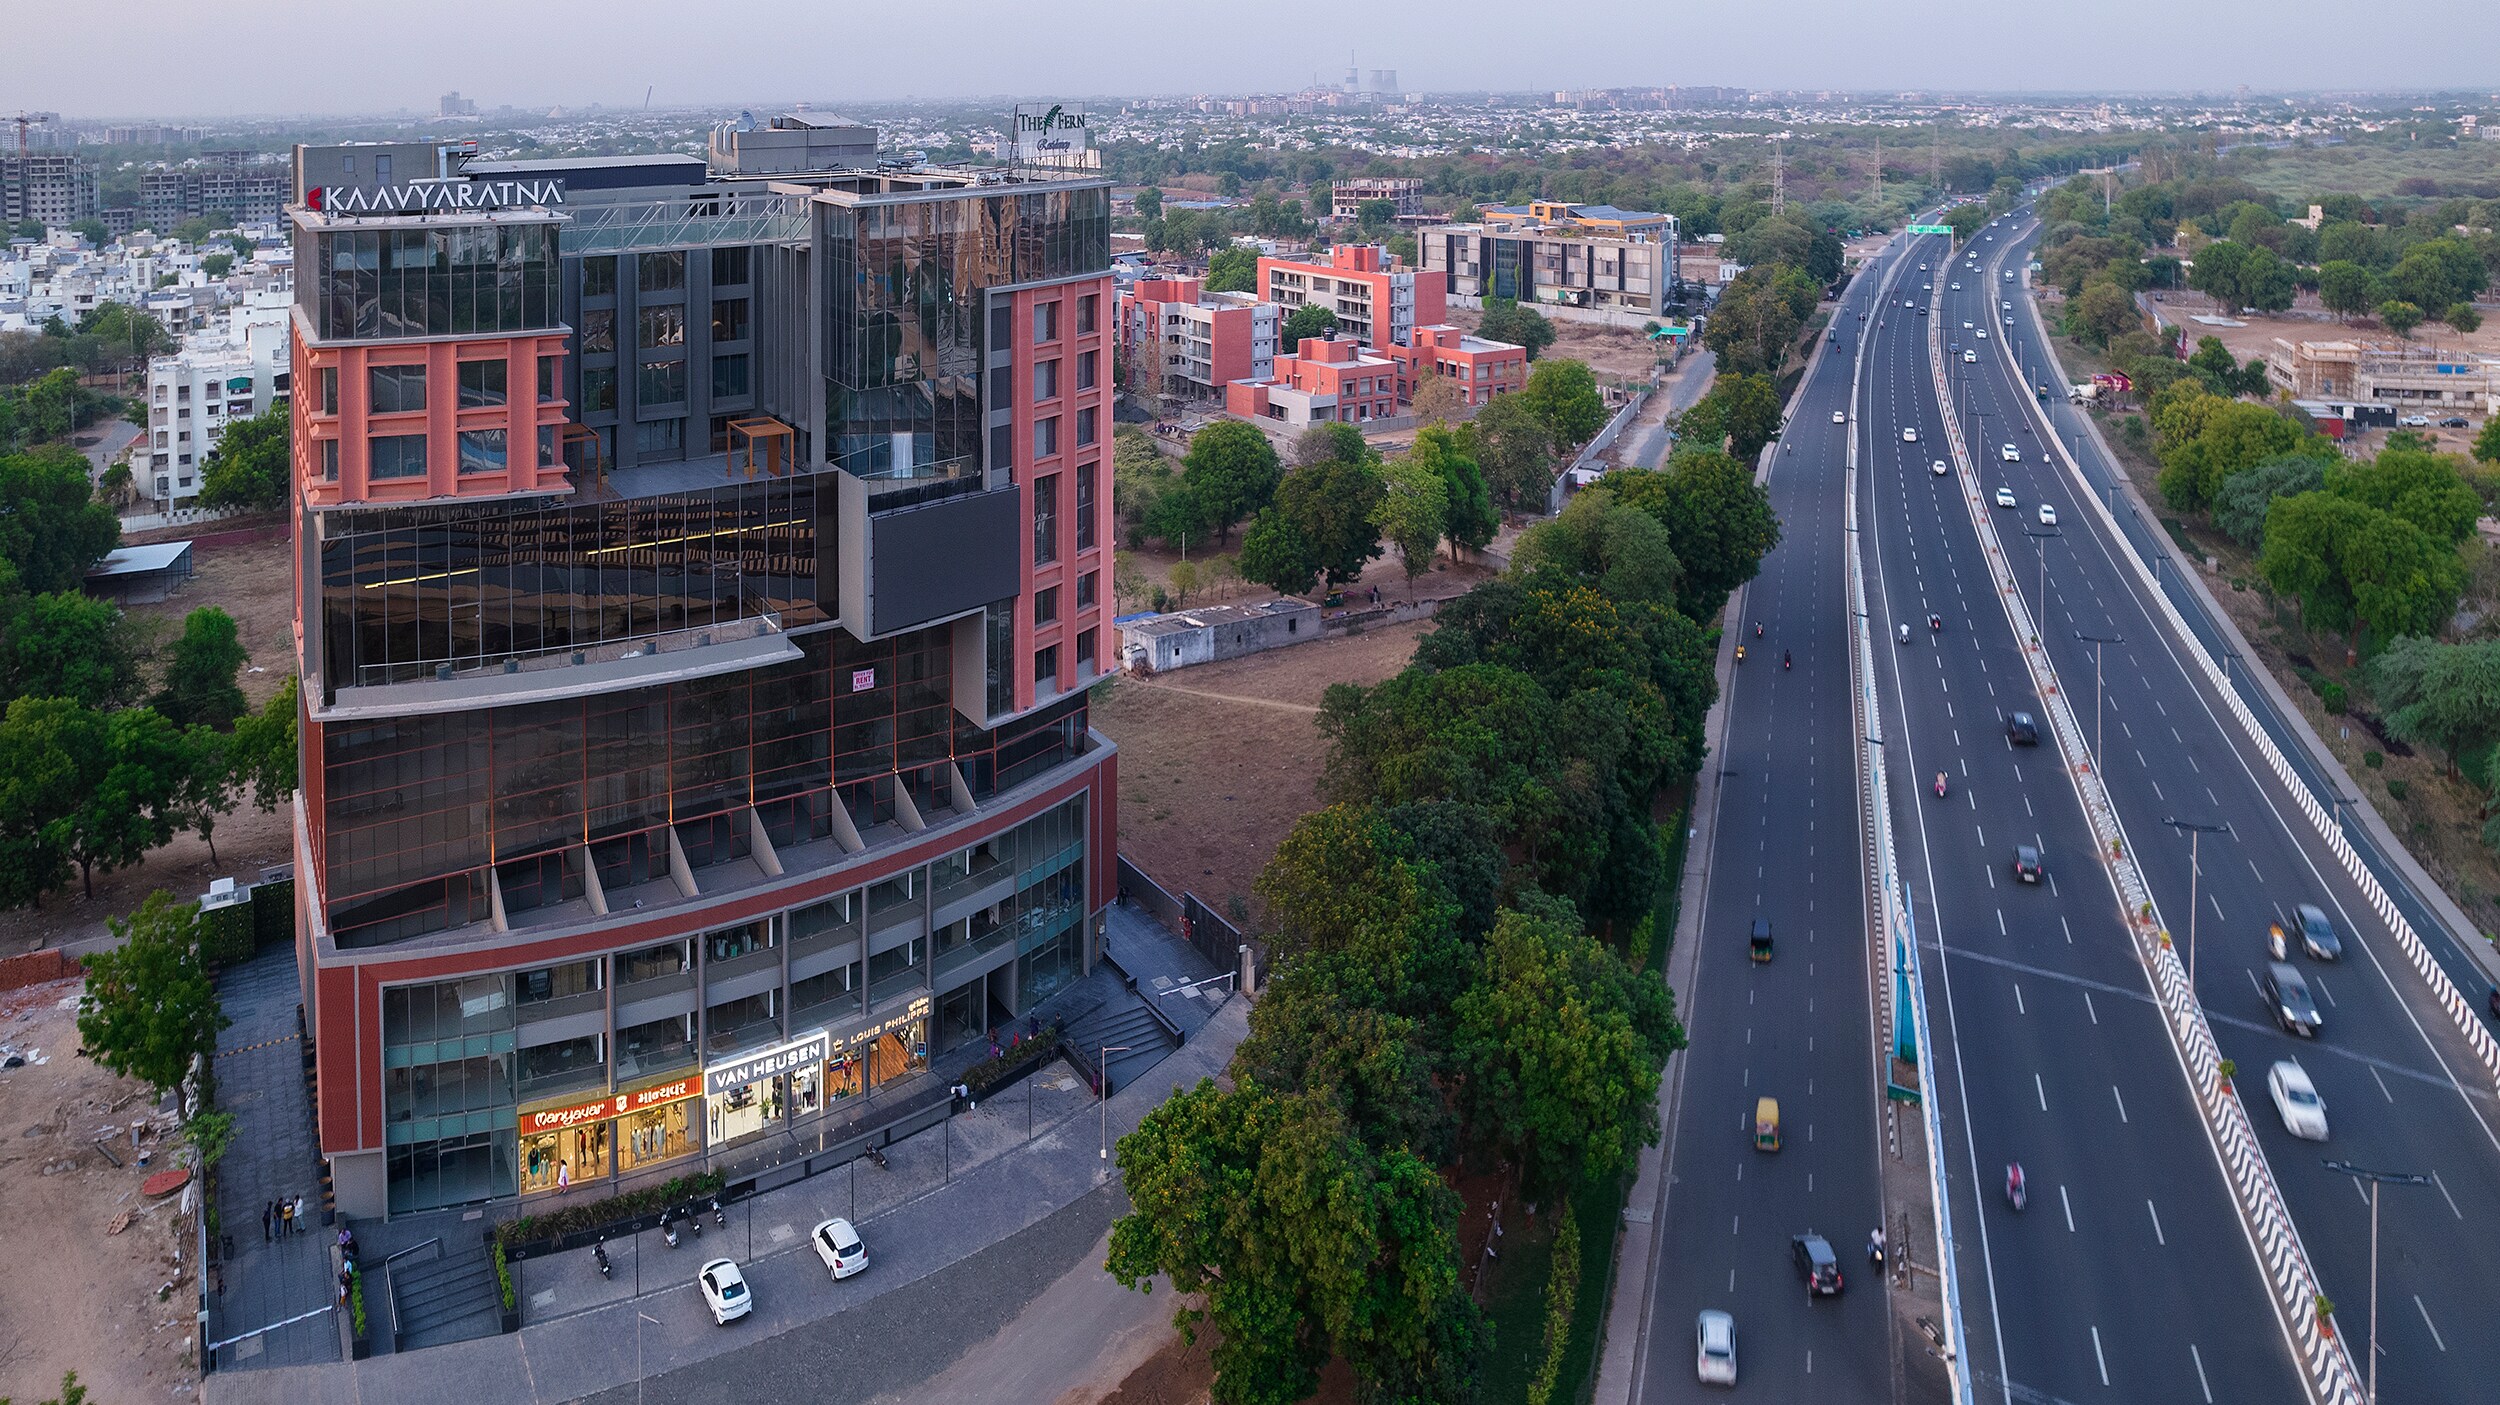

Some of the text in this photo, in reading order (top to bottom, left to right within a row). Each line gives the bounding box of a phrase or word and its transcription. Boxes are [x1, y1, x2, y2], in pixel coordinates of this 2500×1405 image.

[1018, 112, 1085, 132] THE FERN
[325, 180, 563, 211] KAAVYARATNA
[856, 676, 871, 684] RENT
[850, 1005, 929, 1045] LOUIS PHILIPPE
[715, 1066, 749, 1088] VAN
[753, 1042, 820, 1077] HEUSEN
[535, 1103, 605, 1127] Manyavar
